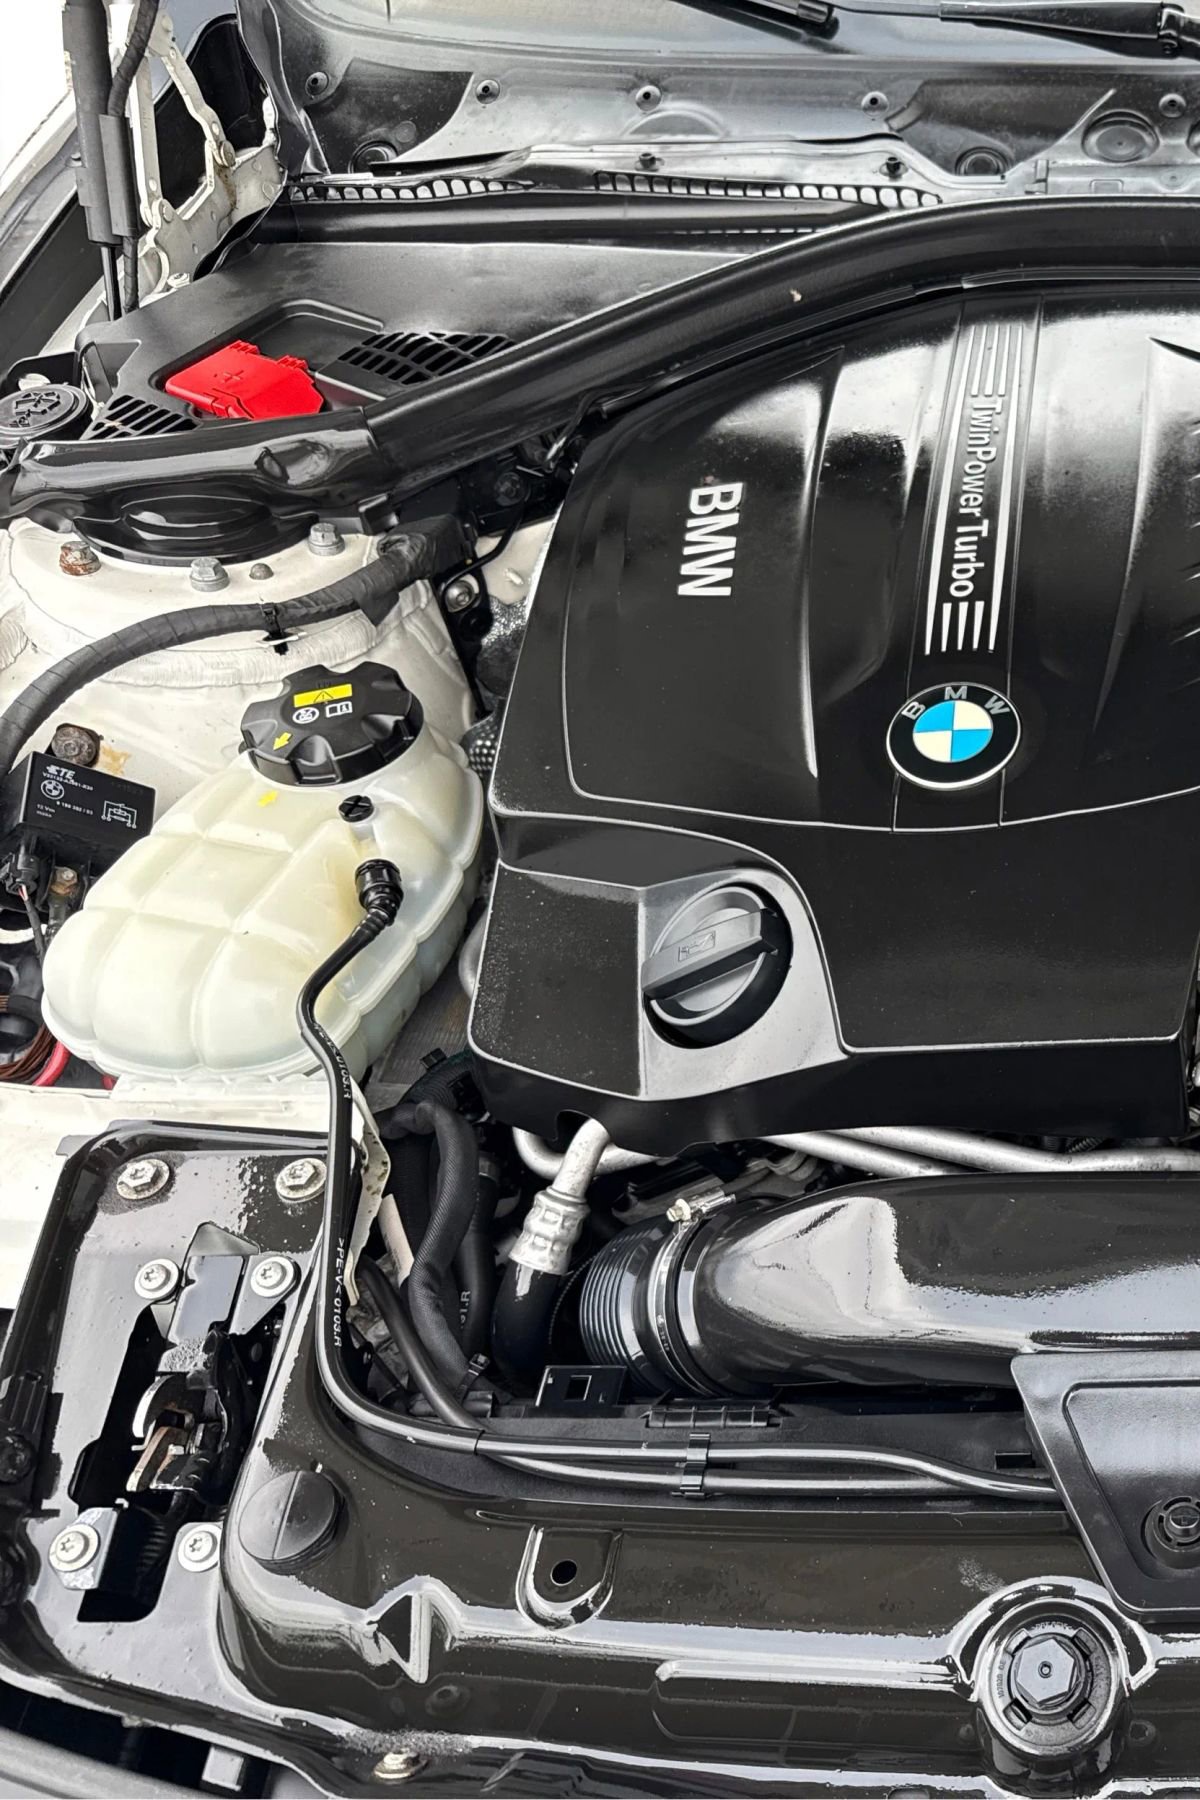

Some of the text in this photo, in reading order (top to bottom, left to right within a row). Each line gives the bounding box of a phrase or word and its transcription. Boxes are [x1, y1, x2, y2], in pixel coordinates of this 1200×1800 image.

[677, 482, 744, 596] BMW
[949, 399, 1002, 598] TwinPower Turbo
[900, 685, 1011, 721] BMW
